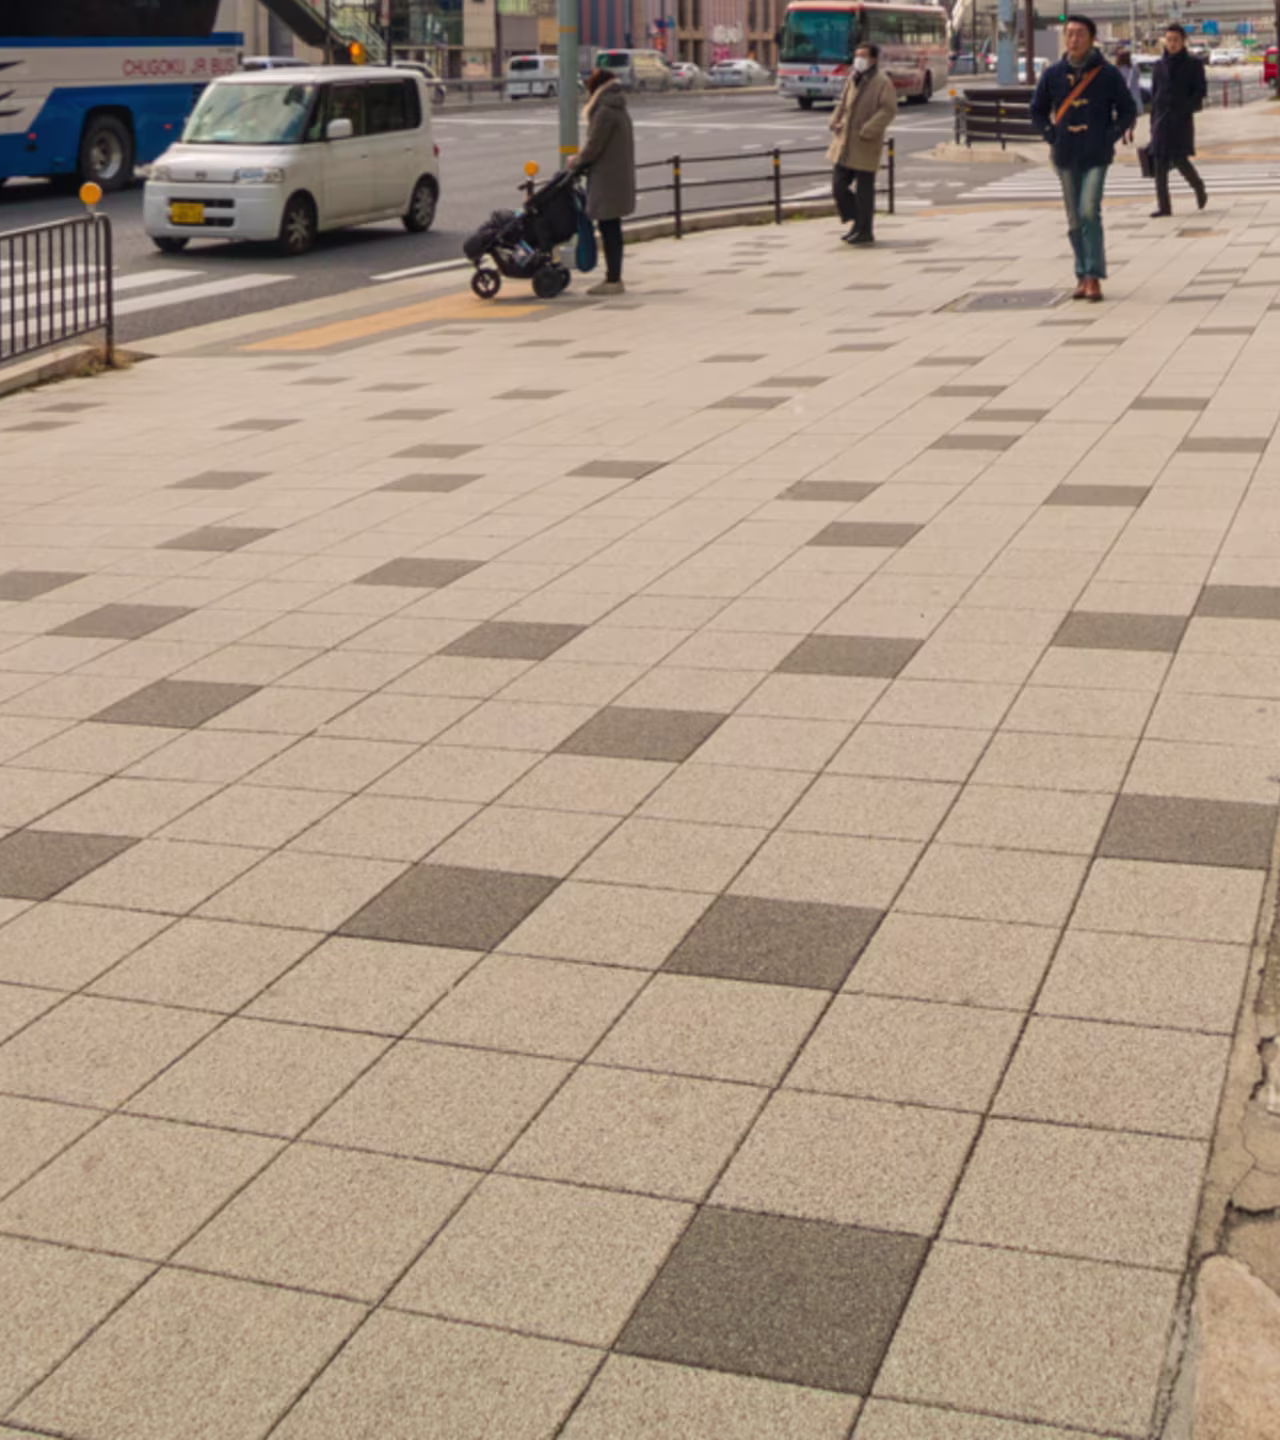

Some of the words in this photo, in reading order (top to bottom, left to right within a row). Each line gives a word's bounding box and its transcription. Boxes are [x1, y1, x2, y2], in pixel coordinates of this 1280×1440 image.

[122, 58, 187, 77] CHUGOKU
[191, 57, 207, 75] JR
[210, 56, 237, 76] BUS
